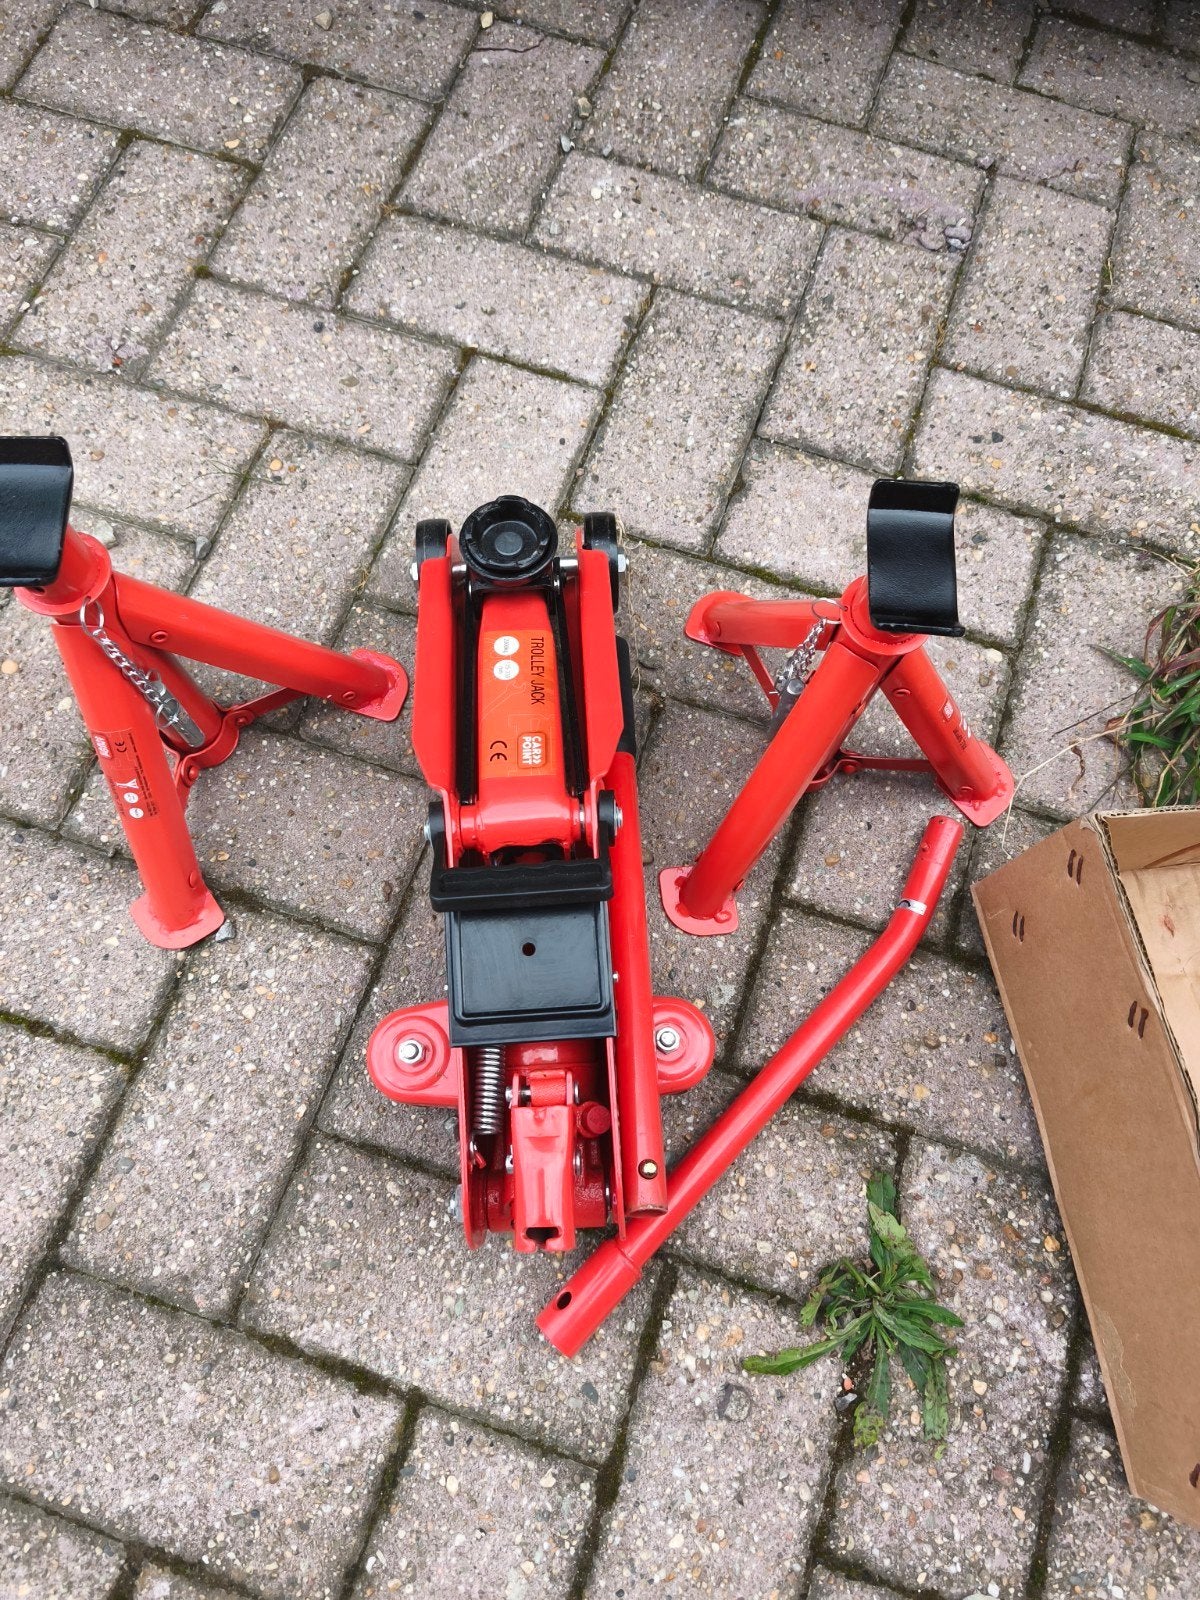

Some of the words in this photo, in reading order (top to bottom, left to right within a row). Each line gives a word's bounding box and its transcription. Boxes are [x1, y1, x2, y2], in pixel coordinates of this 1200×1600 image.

[530, 636, 545, 678] TROLLEY
[530, 679, 546, 706] JACK
[521, 735, 532, 765] POINT
